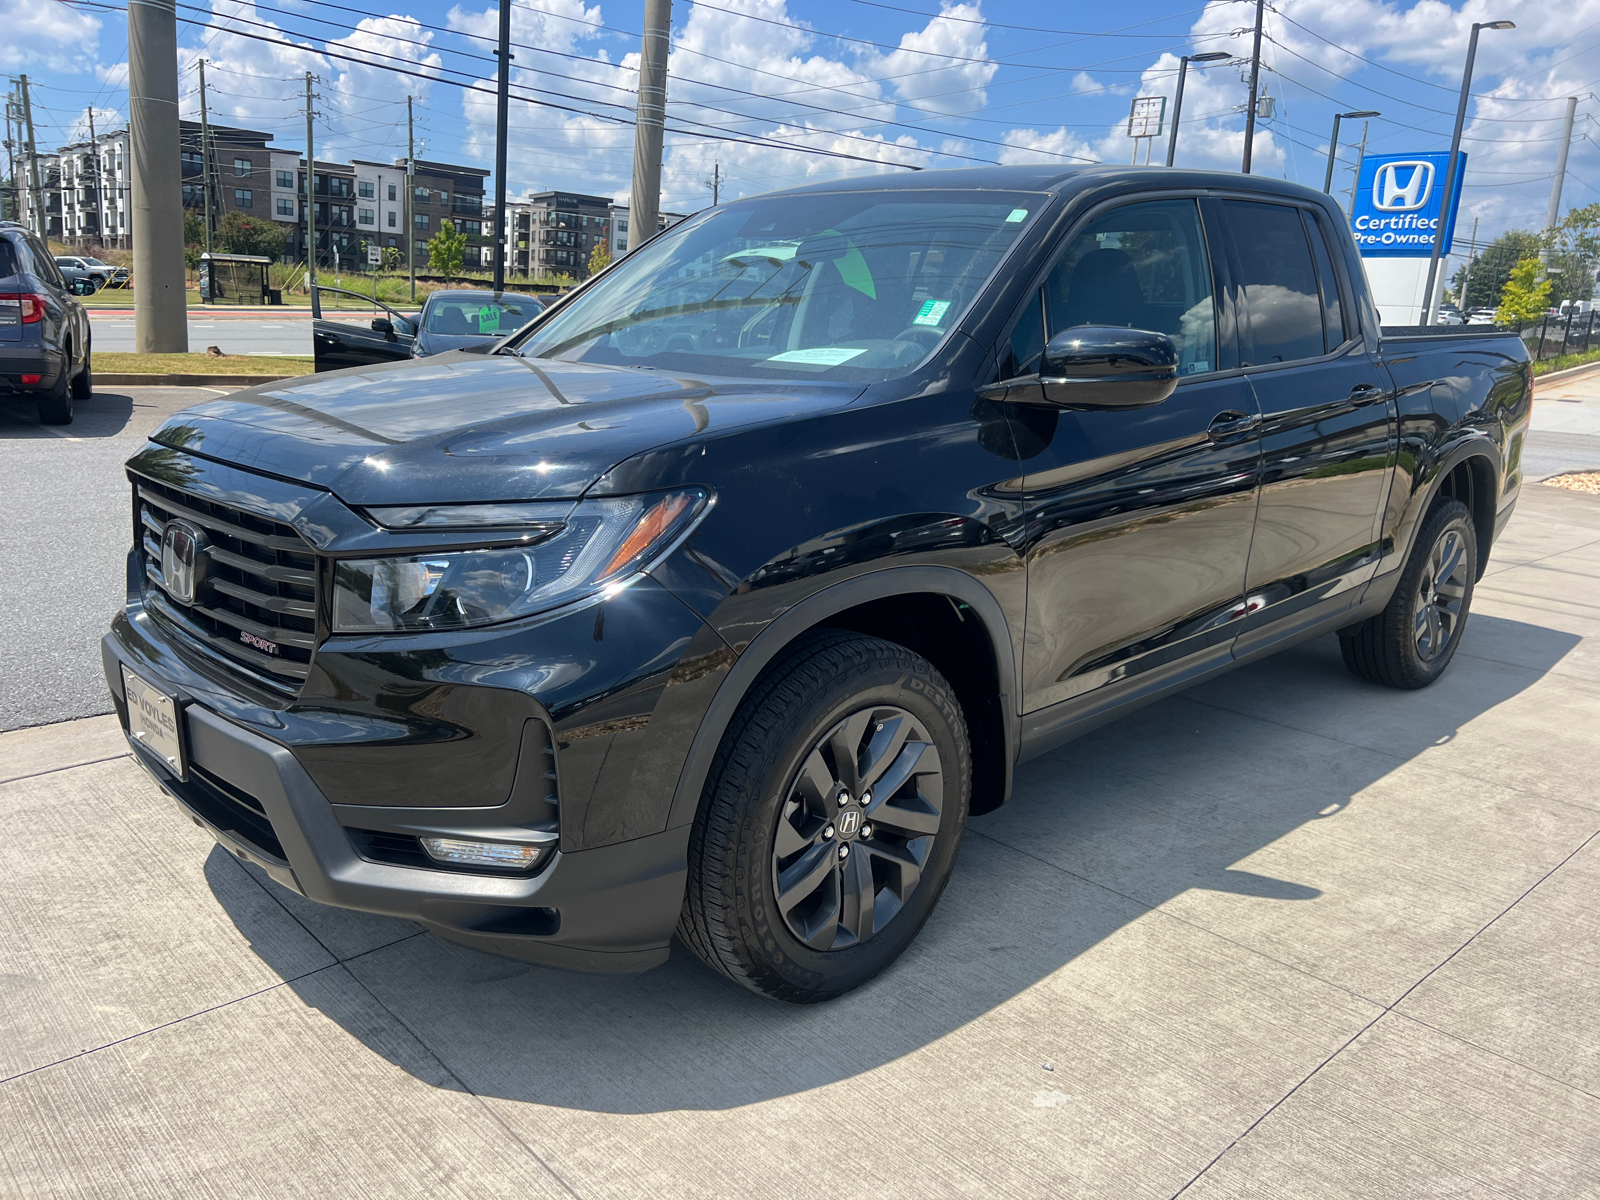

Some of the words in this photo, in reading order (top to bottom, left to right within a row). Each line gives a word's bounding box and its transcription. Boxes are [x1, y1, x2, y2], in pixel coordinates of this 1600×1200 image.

[481, 312, 498, 323] SALE
[240, 631, 276, 653] SPORT
[126, 686, 138, 705] ED
[139, 696, 175, 733] VOYLES
[140, 713, 165, 740] HONDA
[910, 677, 967, 824] DESTINATION
